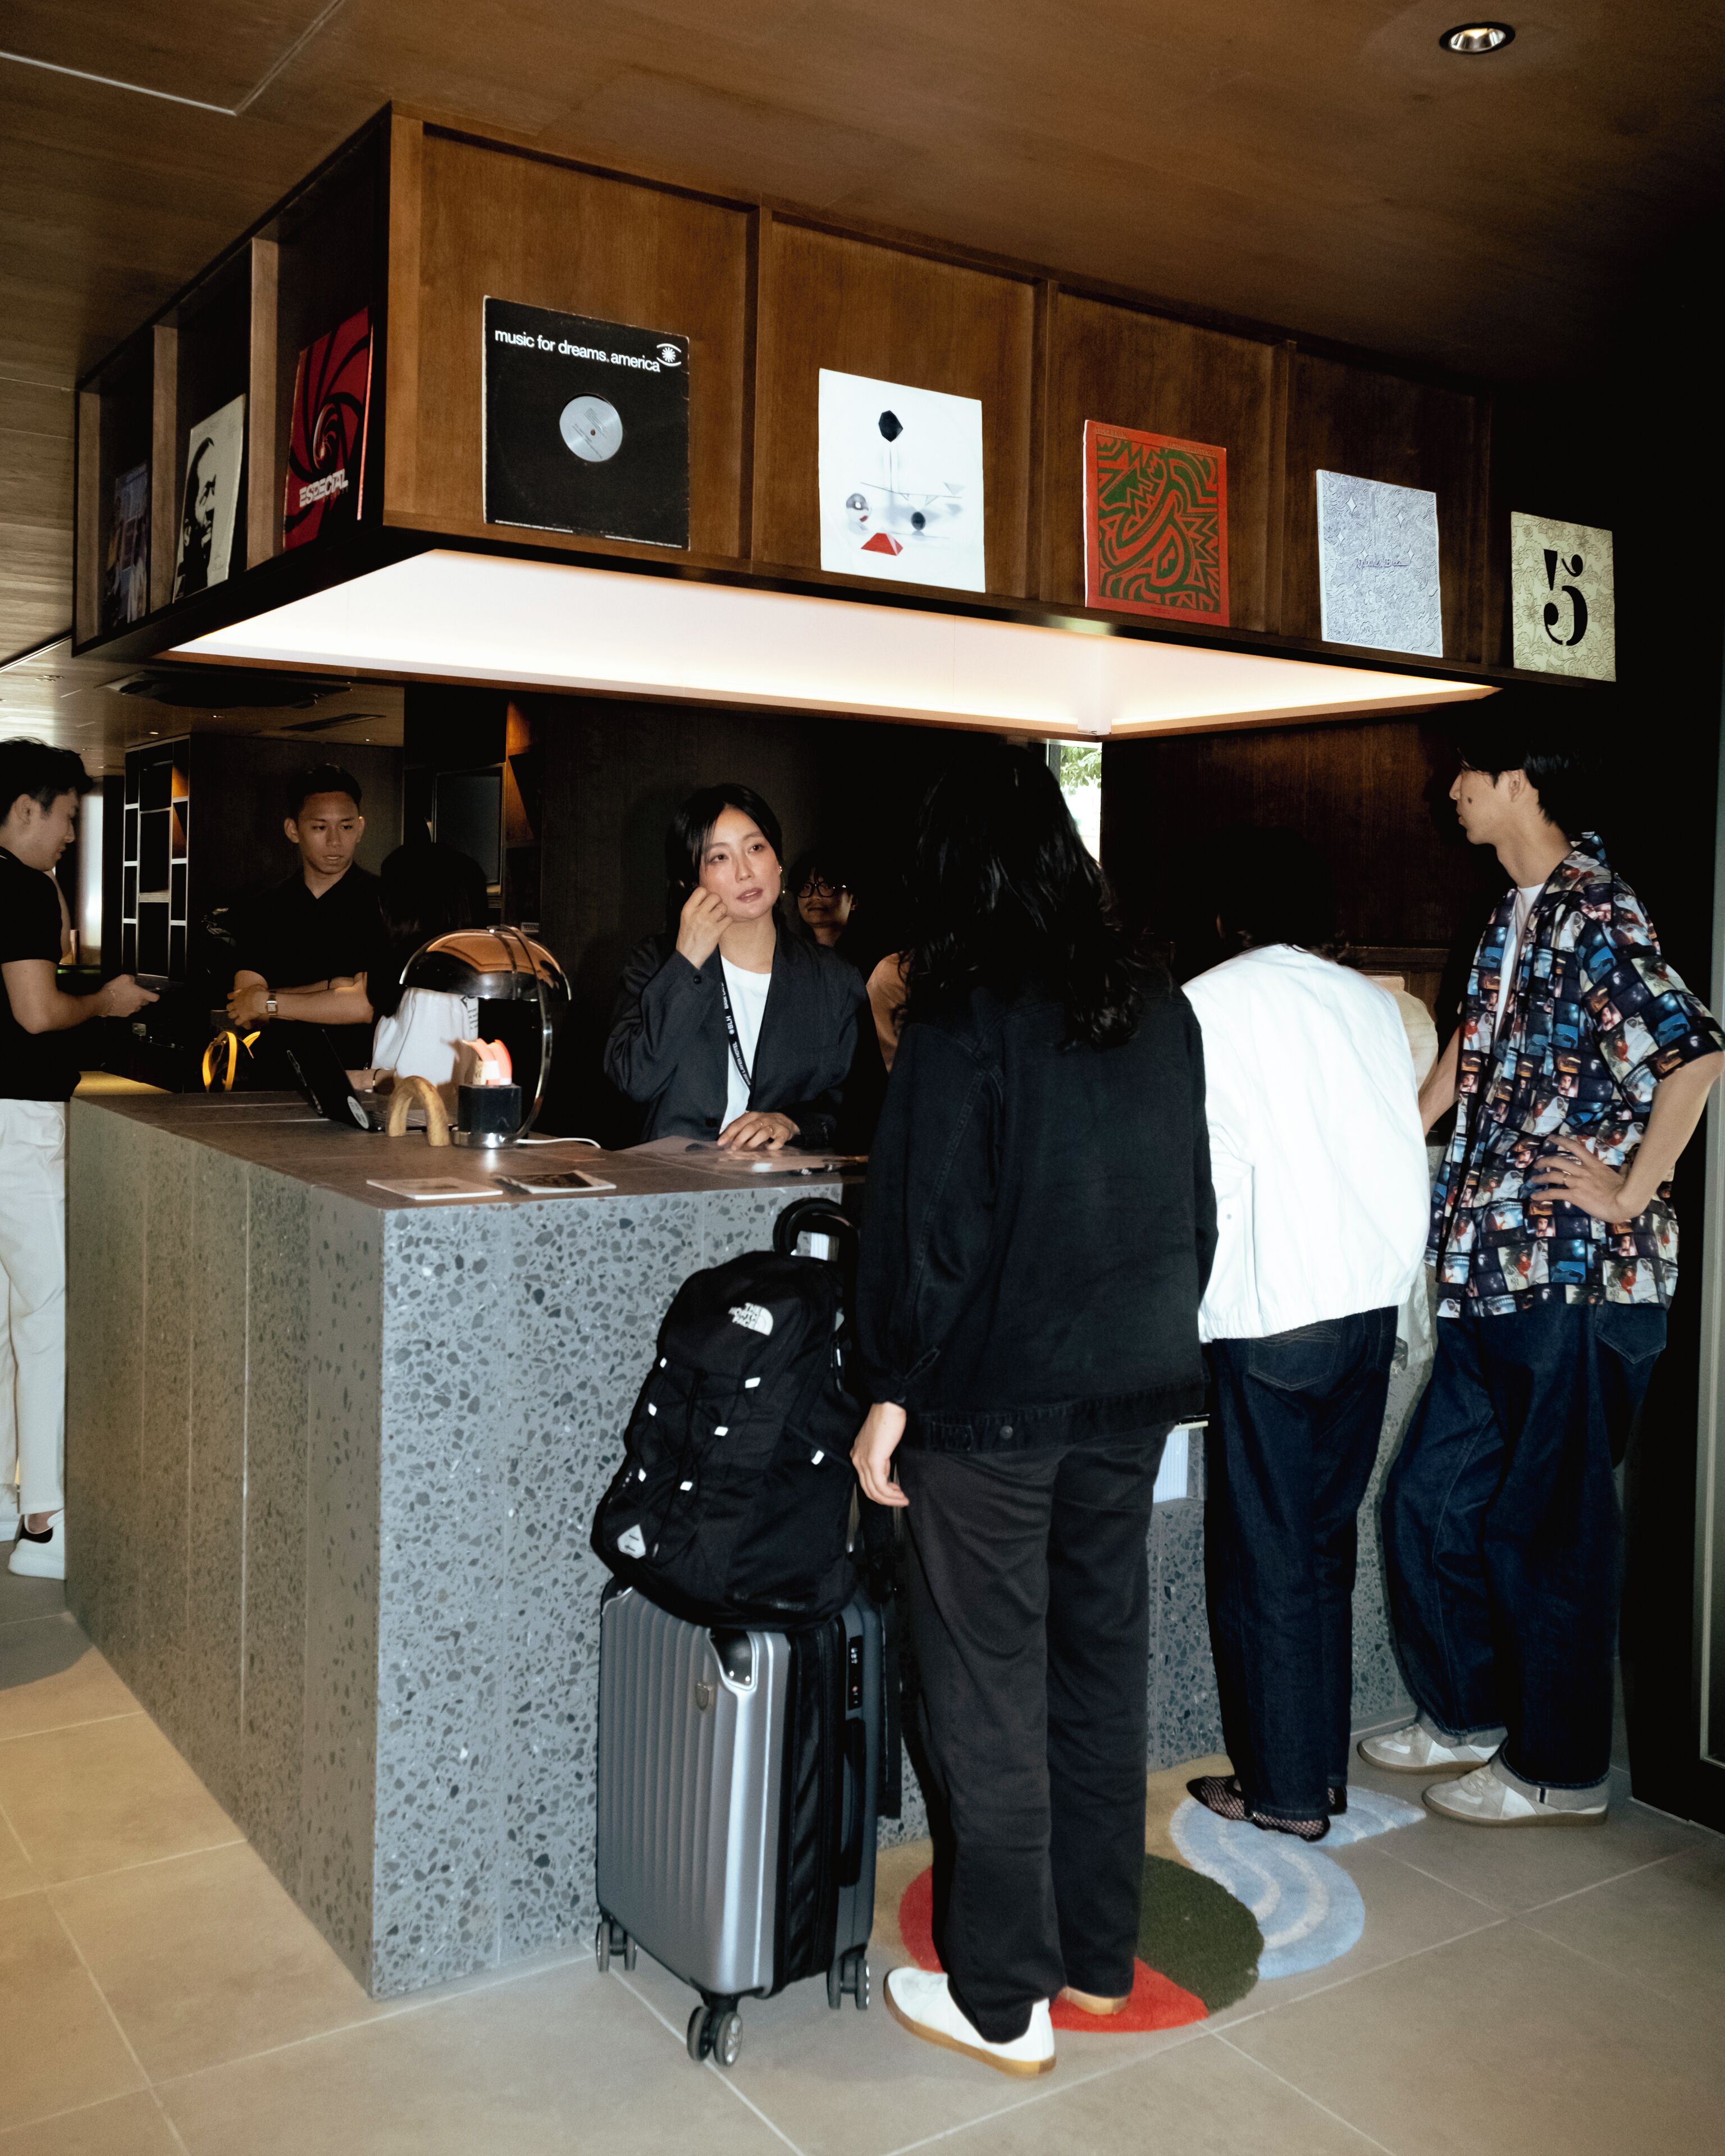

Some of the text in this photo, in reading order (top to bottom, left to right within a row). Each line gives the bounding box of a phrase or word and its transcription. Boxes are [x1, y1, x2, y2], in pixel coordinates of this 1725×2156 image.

[495, 330, 535, 348] music
[537, 335, 555, 351] for
[299, 468, 349, 508] ESPECIAL
[1543, 549, 1588, 646] 5
